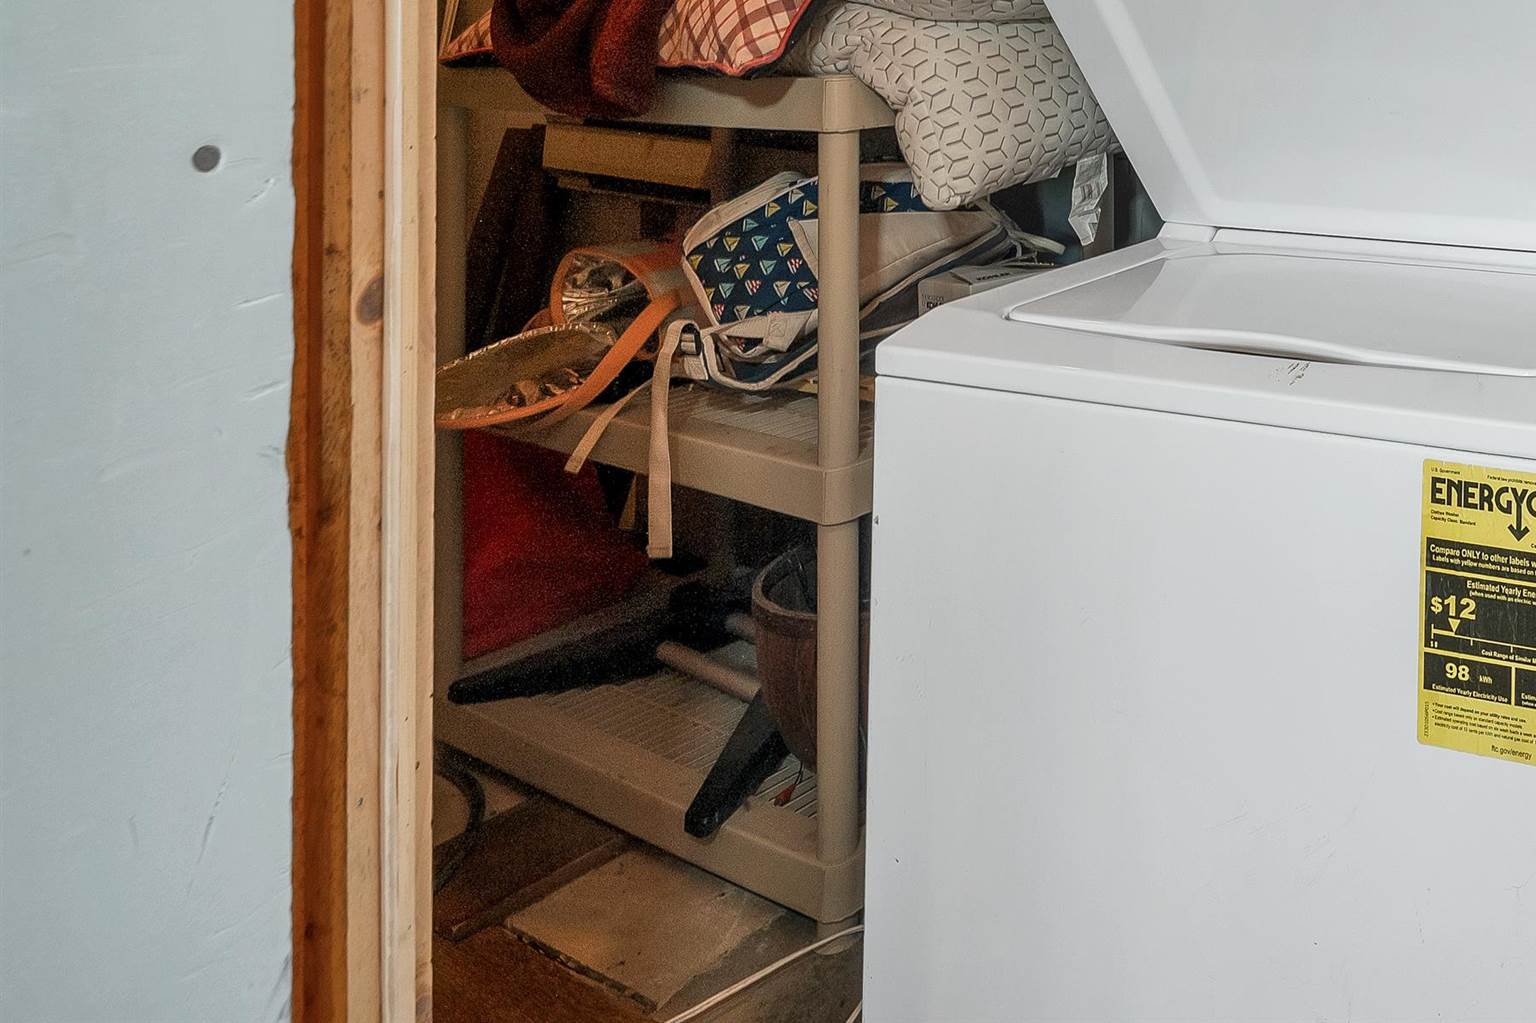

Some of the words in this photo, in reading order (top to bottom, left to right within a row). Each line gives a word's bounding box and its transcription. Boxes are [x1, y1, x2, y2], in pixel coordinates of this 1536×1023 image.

[1430, 544, 1460, 556] Compare
[1461, 549, 1481, 559] ONLY
[1482, 552, 1489, 560] to
[1490, 553, 1508, 563] other
[1509, 556, 1530, 567] labels
[1432, 554, 1449, 563] Labels
[1461, 559, 1478, 567] yellow
[1478, 563, 1500, 571] numbers
[1510, 566, 1526, 574] based
[1466, 580, 1500, 592] Estimated
[1501, 585, 1522, 596] Yearly
[1430, 595, 1476, 620] $12
[1493, 651, 1508, 660] Range
[1445, 662, 1470, 681] 98
[1480, 675, 1492, 684] kWh
[1432, 684, 1456, 693] Estimated
[1457, 688, 1472, 696] Yearly
[1473, 691, 1497, 701] Electricity
